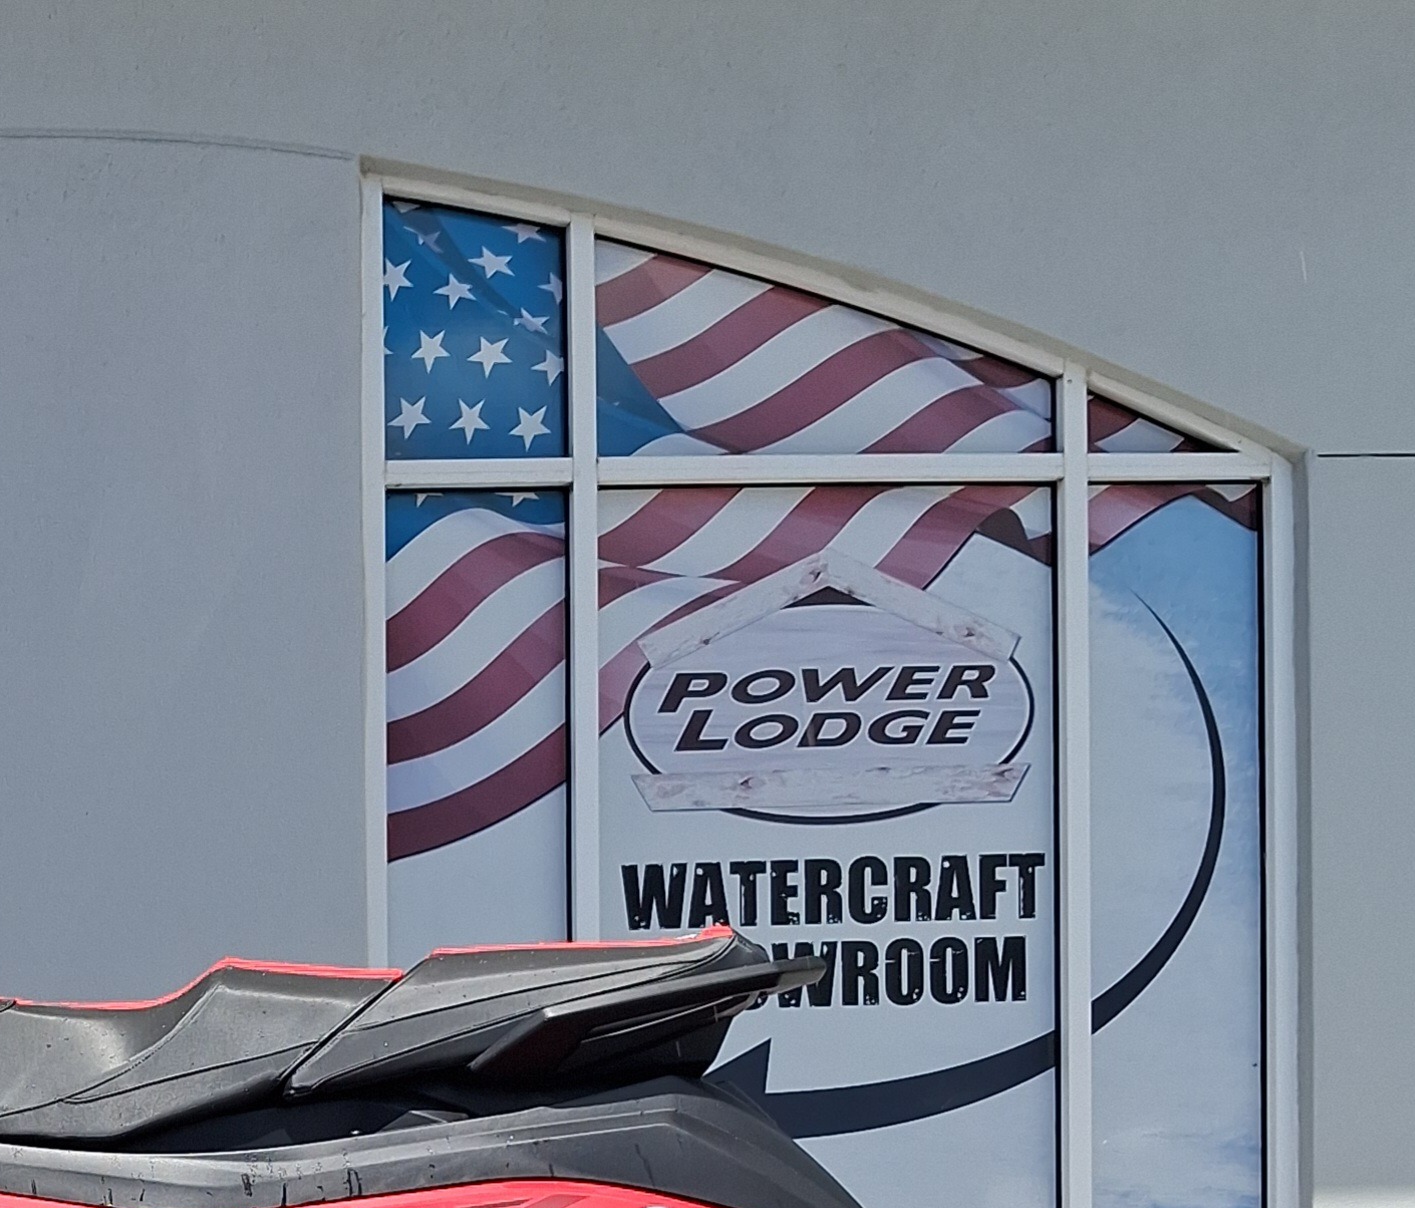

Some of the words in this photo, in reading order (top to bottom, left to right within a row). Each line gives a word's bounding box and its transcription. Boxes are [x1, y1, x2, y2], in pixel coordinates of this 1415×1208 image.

[657, 664, 997, 713] POWER
[674, 709, 982, 752] LODGE
[621, 852, 1046, 931] WATERCRAFT
[744, 935, 1028, 1010] WROOM
